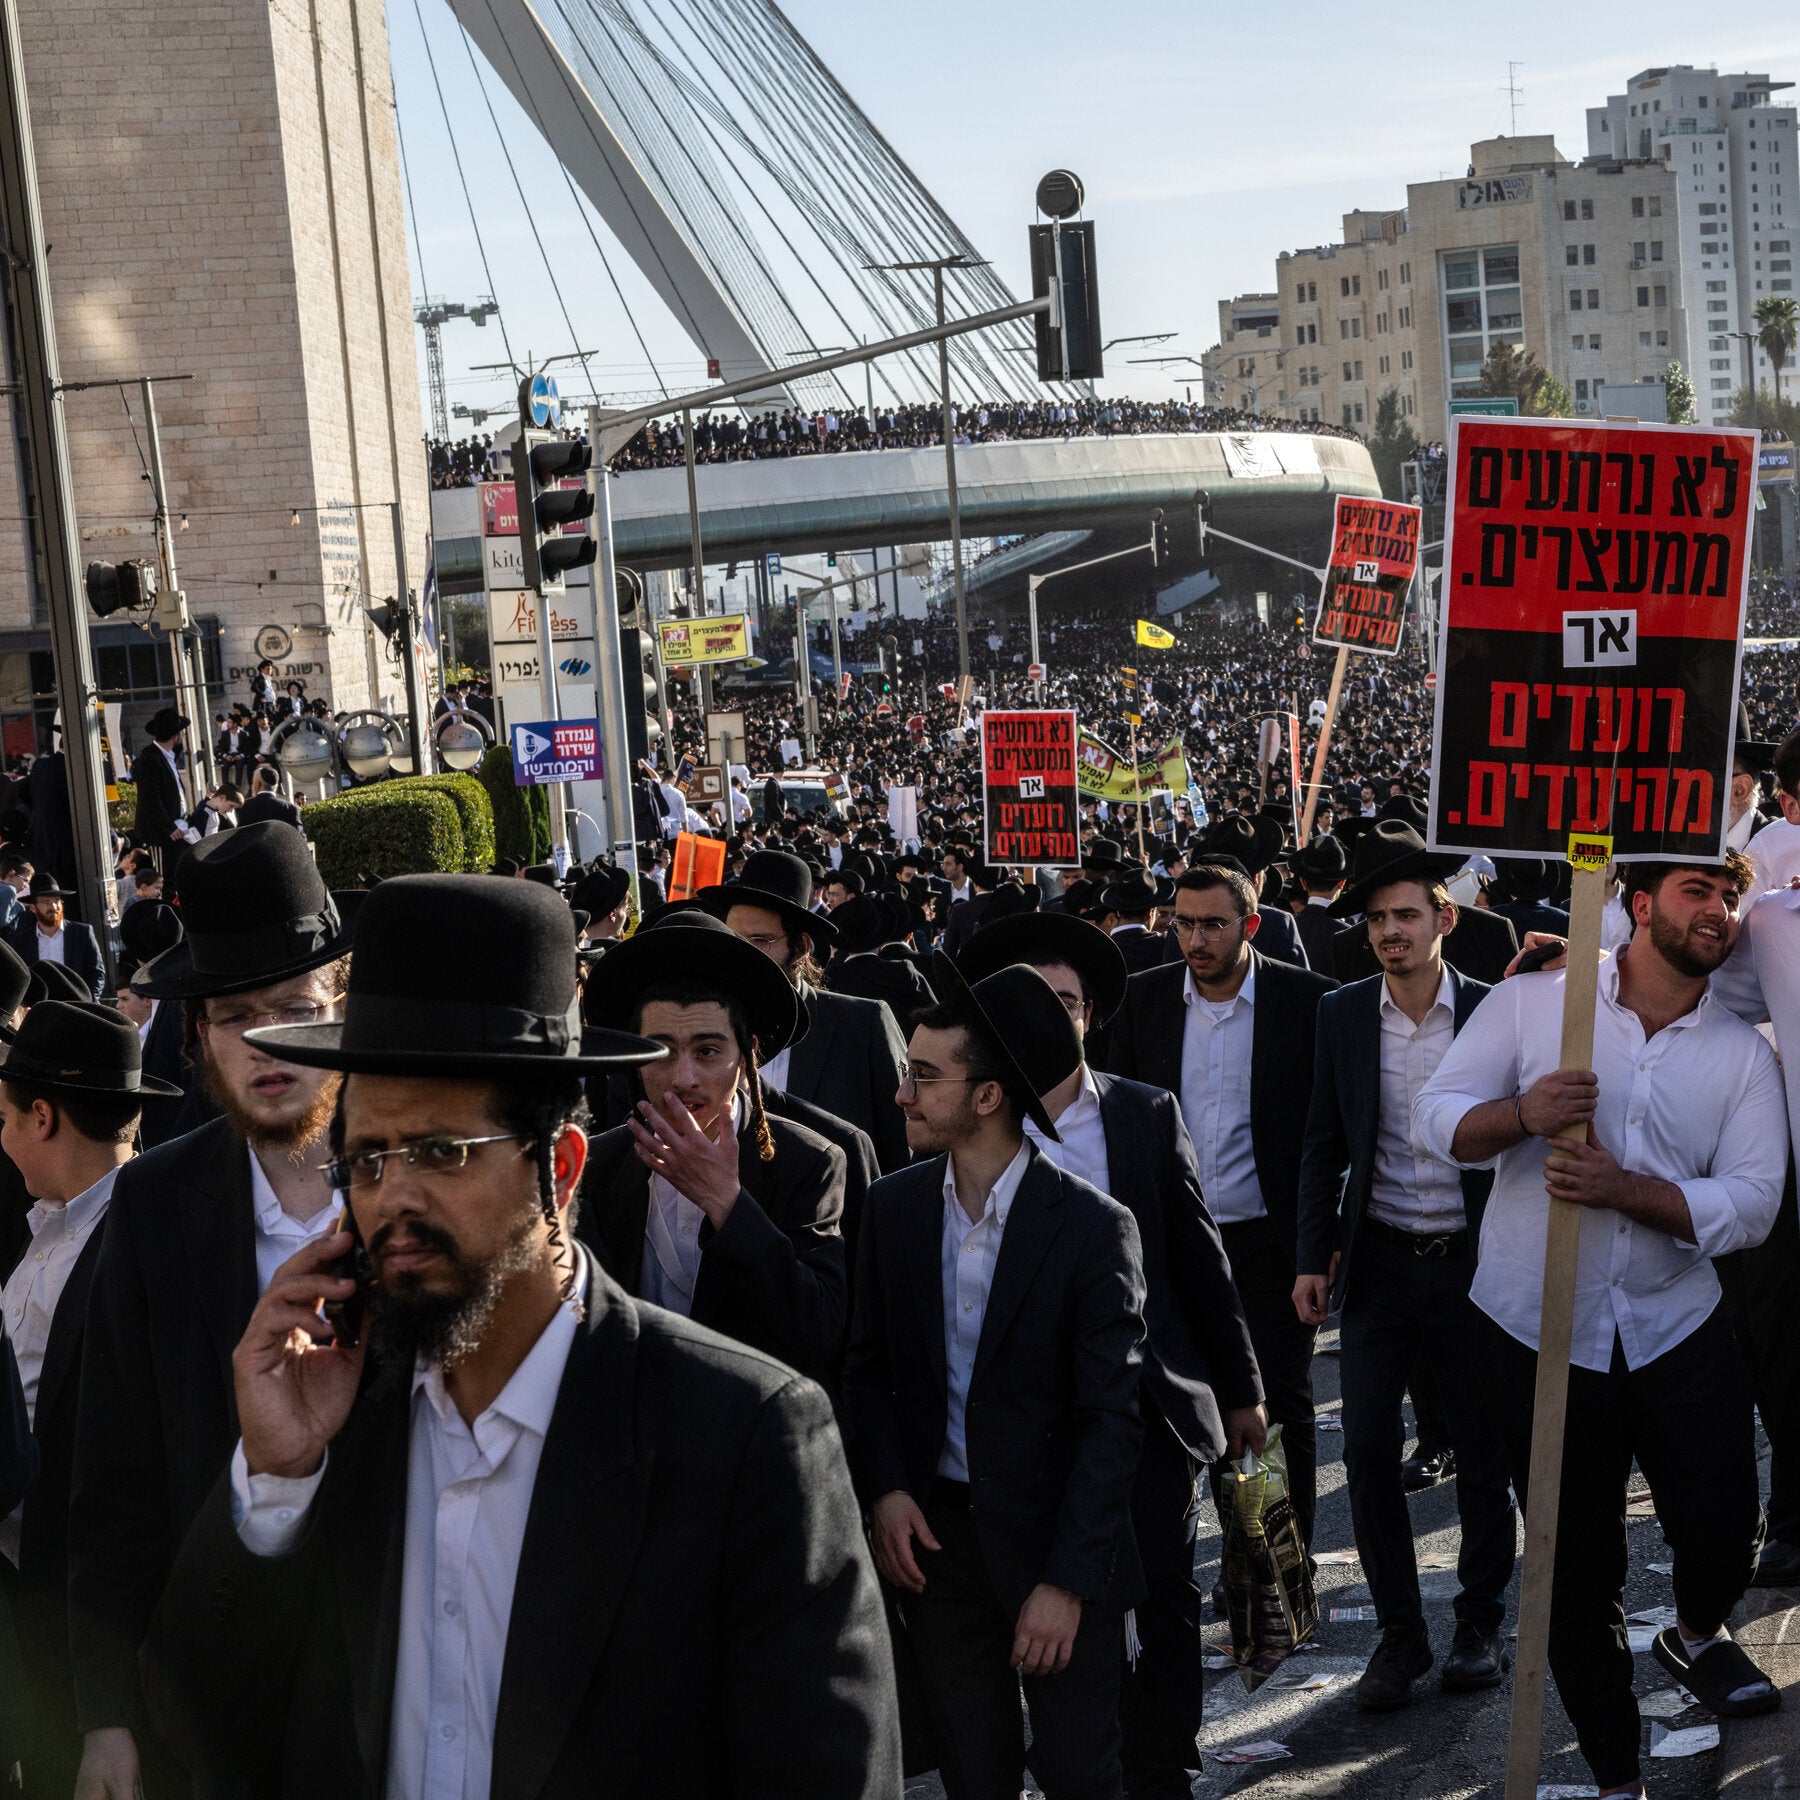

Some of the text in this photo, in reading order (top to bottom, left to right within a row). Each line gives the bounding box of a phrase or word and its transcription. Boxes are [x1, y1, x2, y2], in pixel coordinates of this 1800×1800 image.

[1468, 445, 1740, 519] לא נרתעים
[1396, 511, 1418, 538] לא
[1336, 531, 1415, 564] ממעצרים.
[1461, 523, 1731, 597] ממעצרים.
[1356, 563, 1377, 580] אך
[1334, 583, 1395, 617] רועדים
[517, 617, 578, 634] Fitess
[1318, 609, 1399, 645] מהיעדים.
[1567, 616, 1630, 663] אך
[229, 662, 324, 679] רשות הסים
[499, 657, 540, 682] לפרין
[1050, 717, 1070, 743] לא
[1489, 680, 1686, 754] רועדים
[554, 728, 594, 743] עמדת
[556, 742, 595, 757] שידור
[988, 748, 1071, 771] ממעצרים.
[1020, 778, 1042, 796] אך
[1447, 759, 1714, 835] מהיעדים.
[1000, 803, 1064, 829] רועדים
[991, 831, 1076, 857] מהיעדים.
